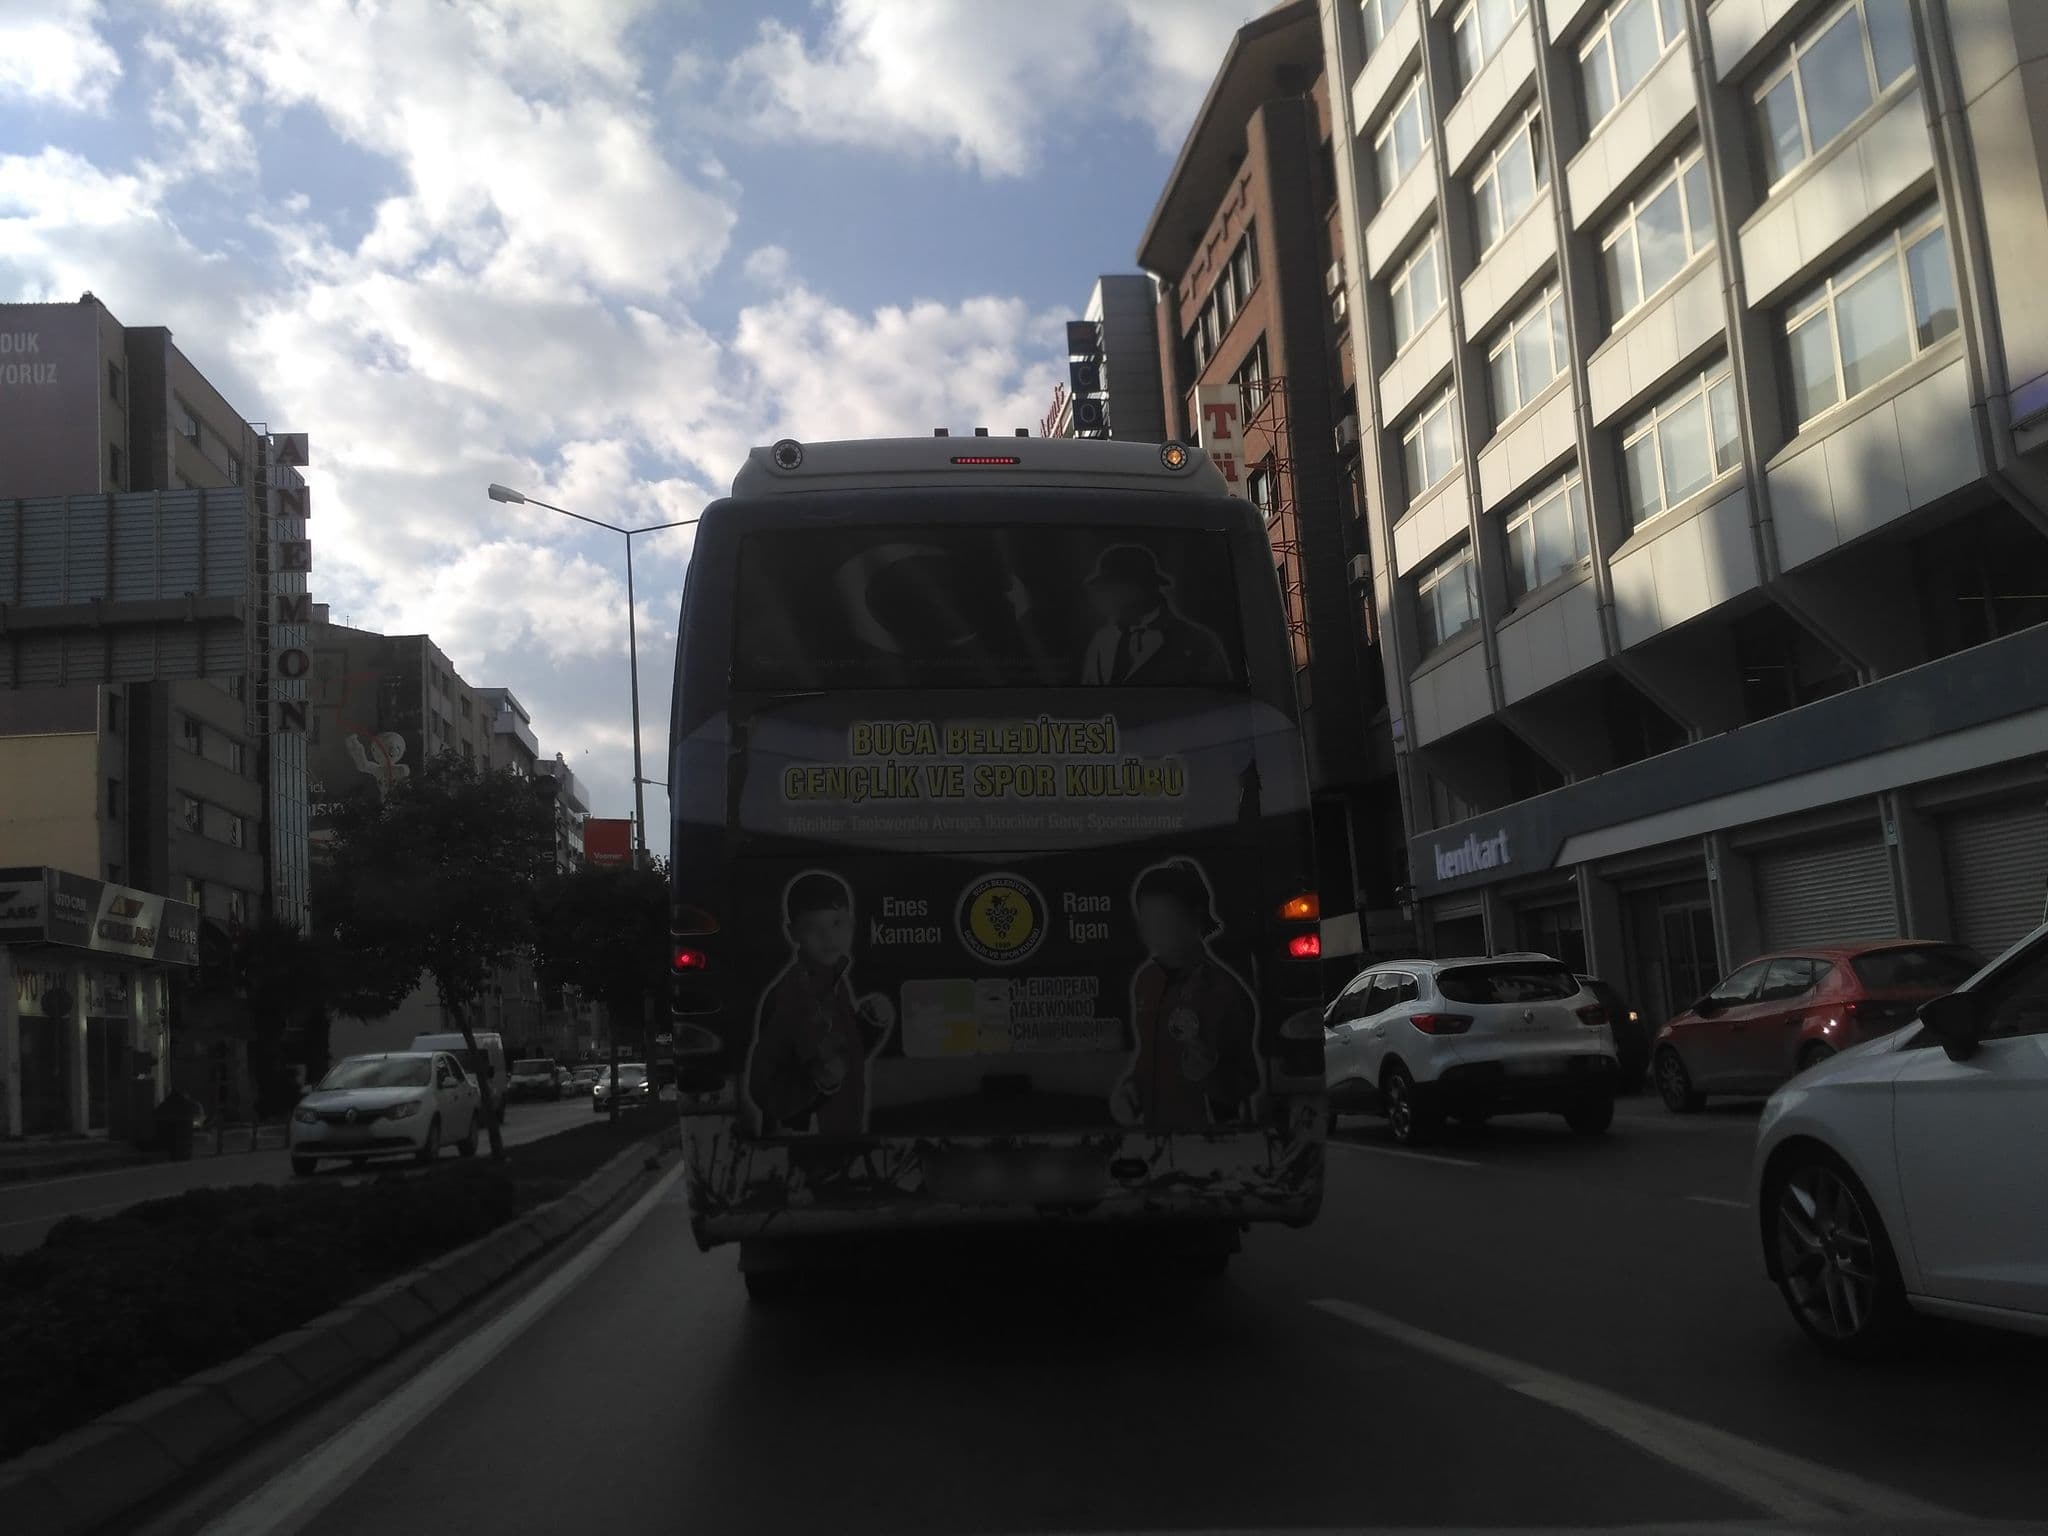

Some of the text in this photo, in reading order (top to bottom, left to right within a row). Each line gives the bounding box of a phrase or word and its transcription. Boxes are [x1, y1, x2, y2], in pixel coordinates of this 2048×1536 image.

[276, 435, 310, 731] ANEMON
[852, 715, 1116, 756] BUCA BELEDİYESİ
[784, 758, 1184, 804] GENÇLİK VE SPOR KULÜBÜ
[1434, 828, 1512, 880] kentkart
[882, 896, 928, 917] Enes
[1063, 892, 1111, 912] Rana
[871, 923, 942, 945] Kamacı
[1029, 979, 1097, 996] EUROPEAN
[1013, 1000, 1094, 1017] TAEKWONDO
